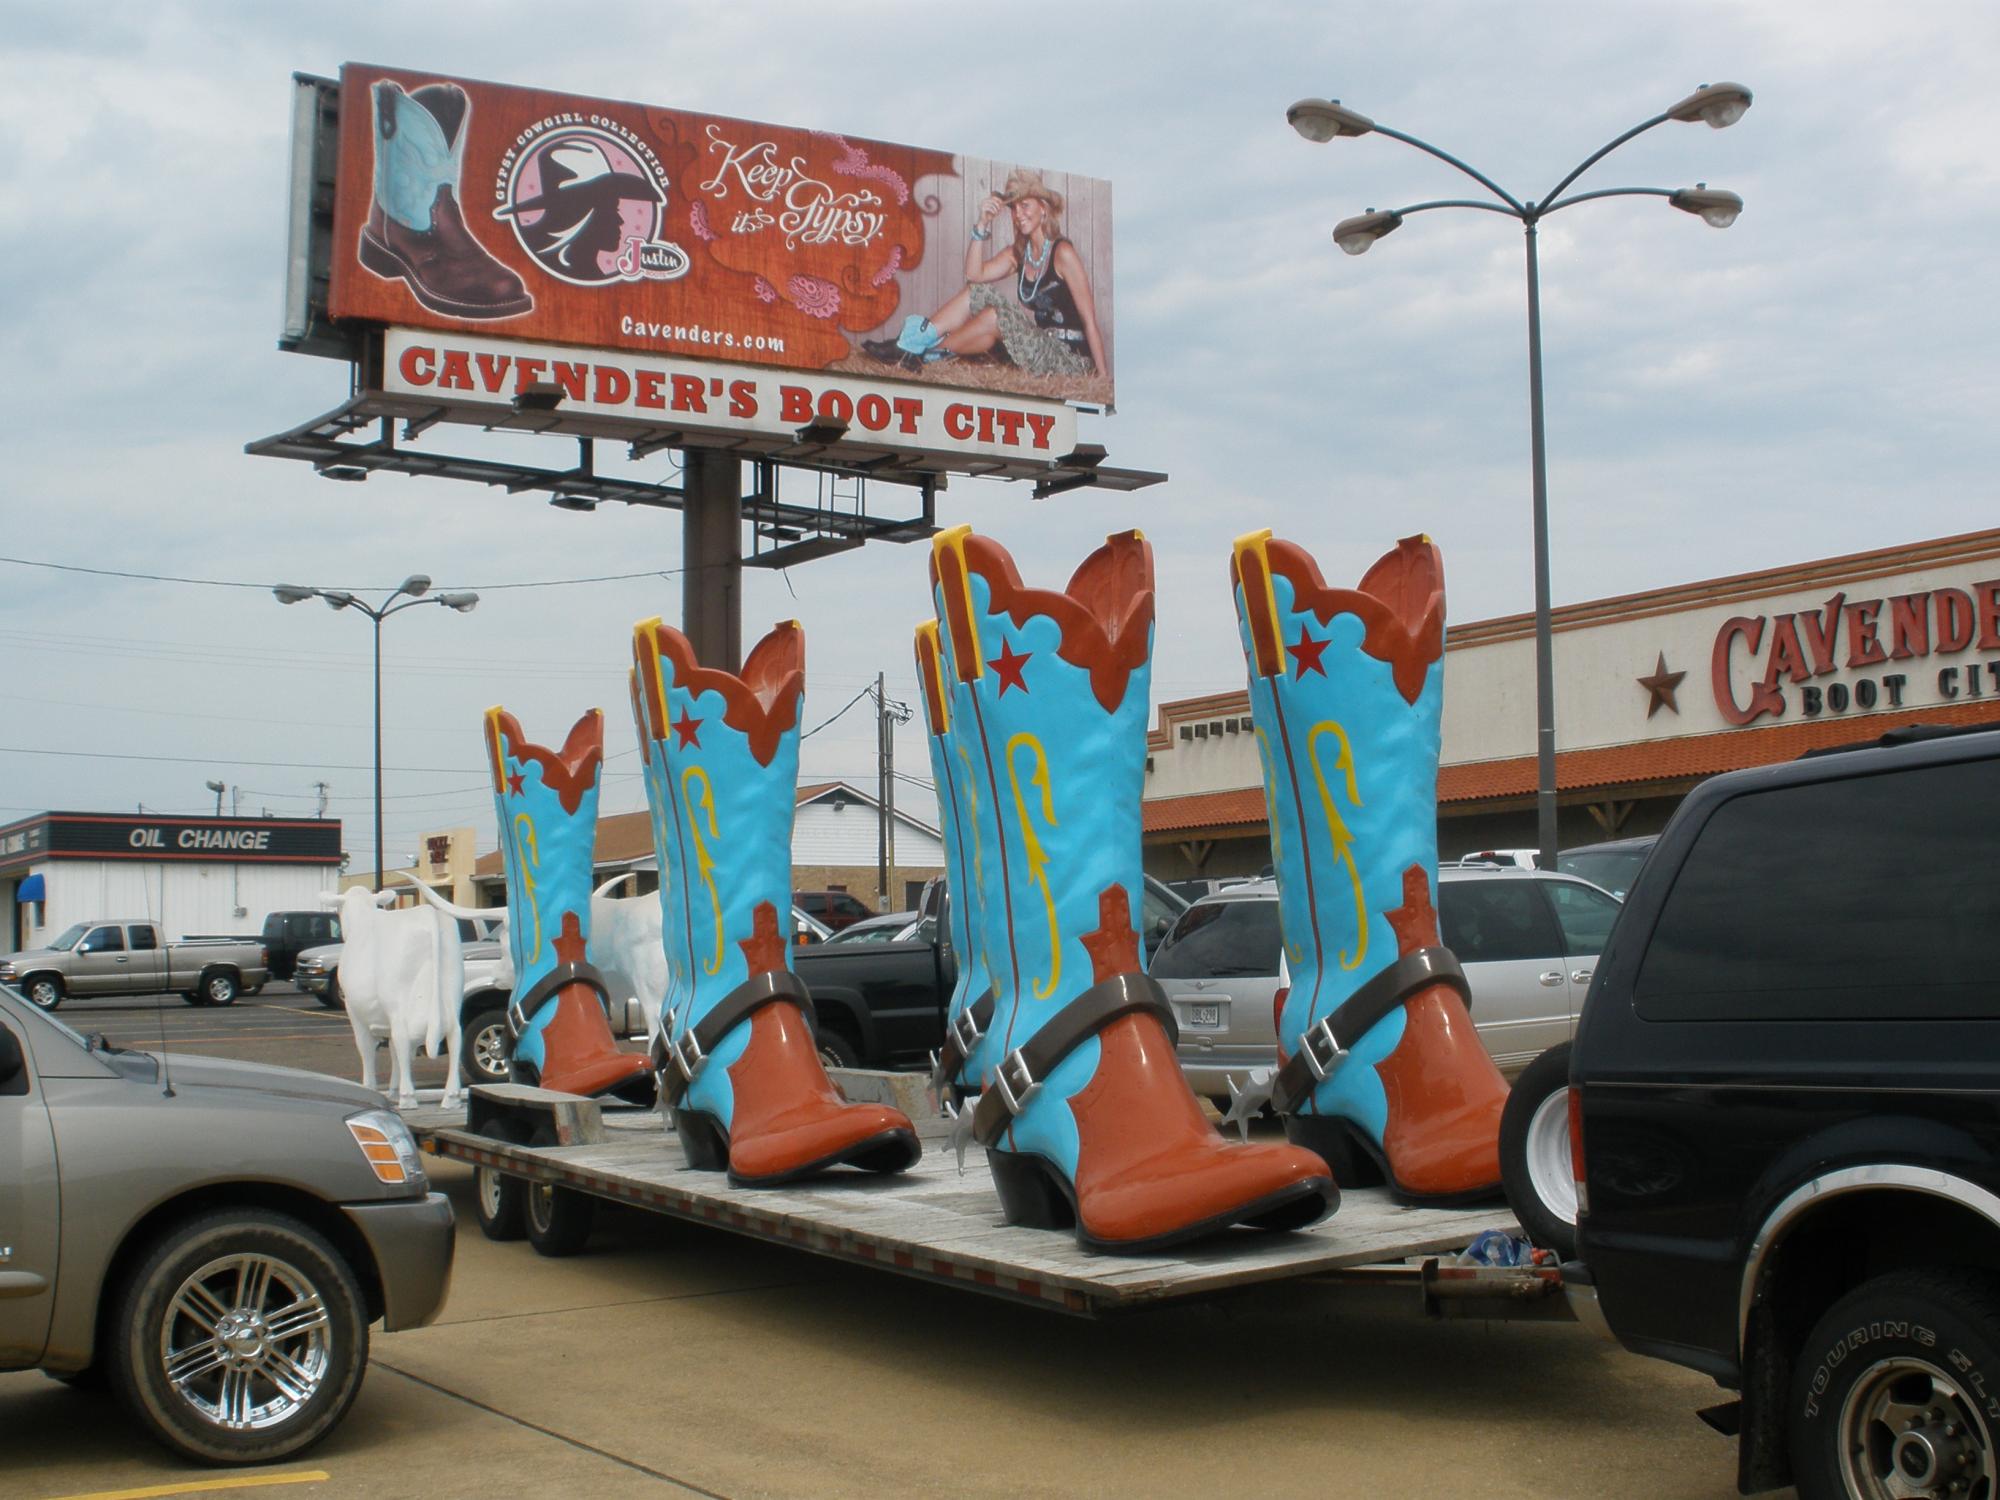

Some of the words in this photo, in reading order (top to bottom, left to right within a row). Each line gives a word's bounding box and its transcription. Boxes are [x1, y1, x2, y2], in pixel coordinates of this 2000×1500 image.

[496, 147, 516, 200] GYPSY
[516, 112, 583, 146] COWGIRL
[590, 113, 671, 189] COLLECTION
[700, 124, 792, 201] Keep
[617, 237, 679, 276] Justin
[620, 315, 785, 353] Cavenders.com
[399, 345, 758, 419] CAVENDER'S
[779, 384, 923, 434] BOOT
[943, 403, 1056, 449] CITY
[1802, 673, 1907, 717] BOOT
[129, 828, 165, 848] OIL
[177, 829, 270, 850] CHANGE
[1804, 1321, 1936, 1418] TOURING
